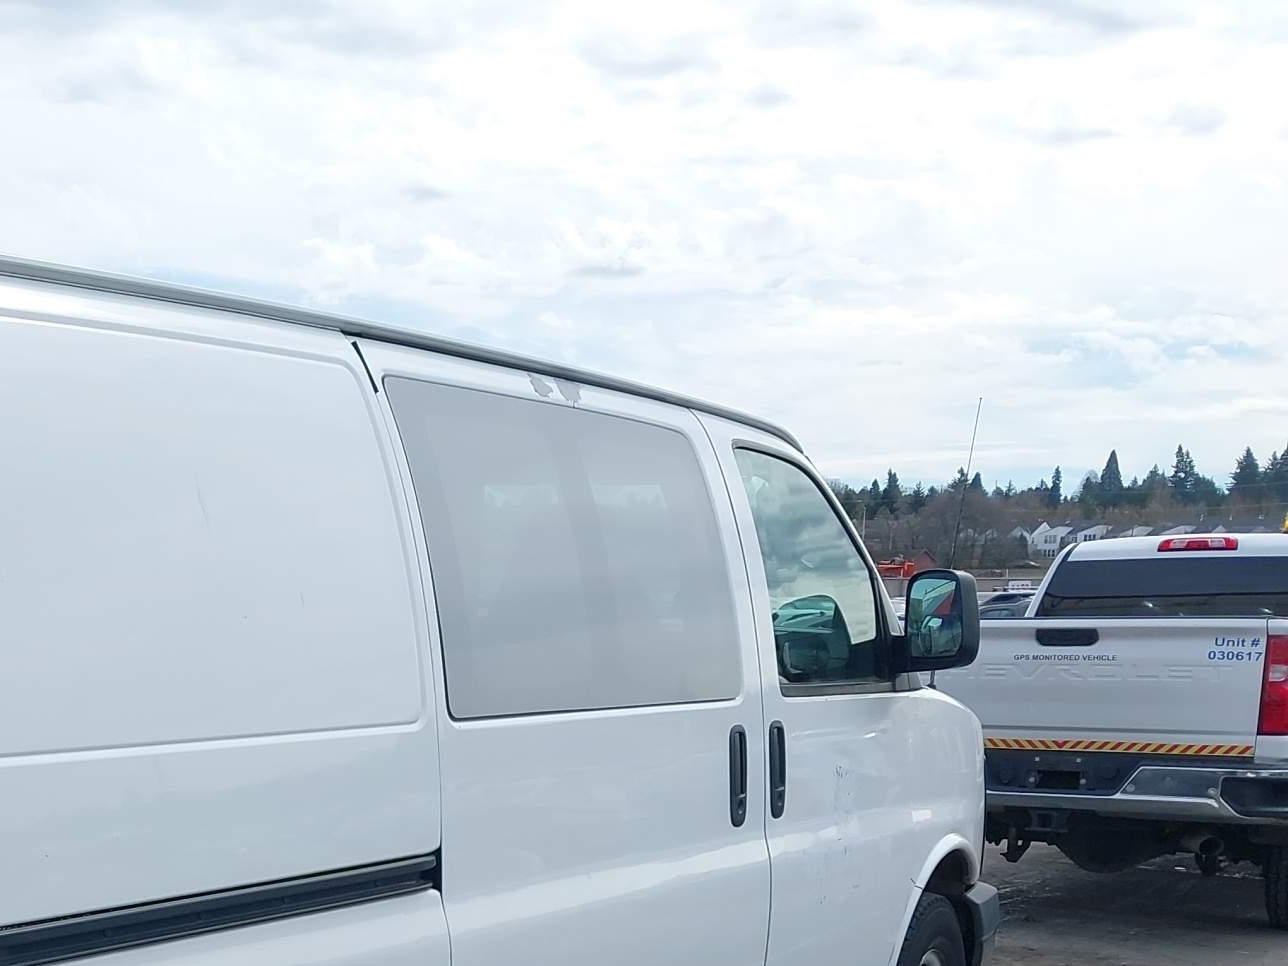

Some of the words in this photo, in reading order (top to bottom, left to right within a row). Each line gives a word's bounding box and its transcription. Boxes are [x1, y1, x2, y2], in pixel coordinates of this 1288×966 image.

[1214, 637, 1246, 648] Unit
[1250, 637, 1261, 648] #
[1031, 654, 1080, 662] MONITORED
[1082, 654, 1118, 662] VEHICLE
[1207, 650, 1263, 662] 030617
